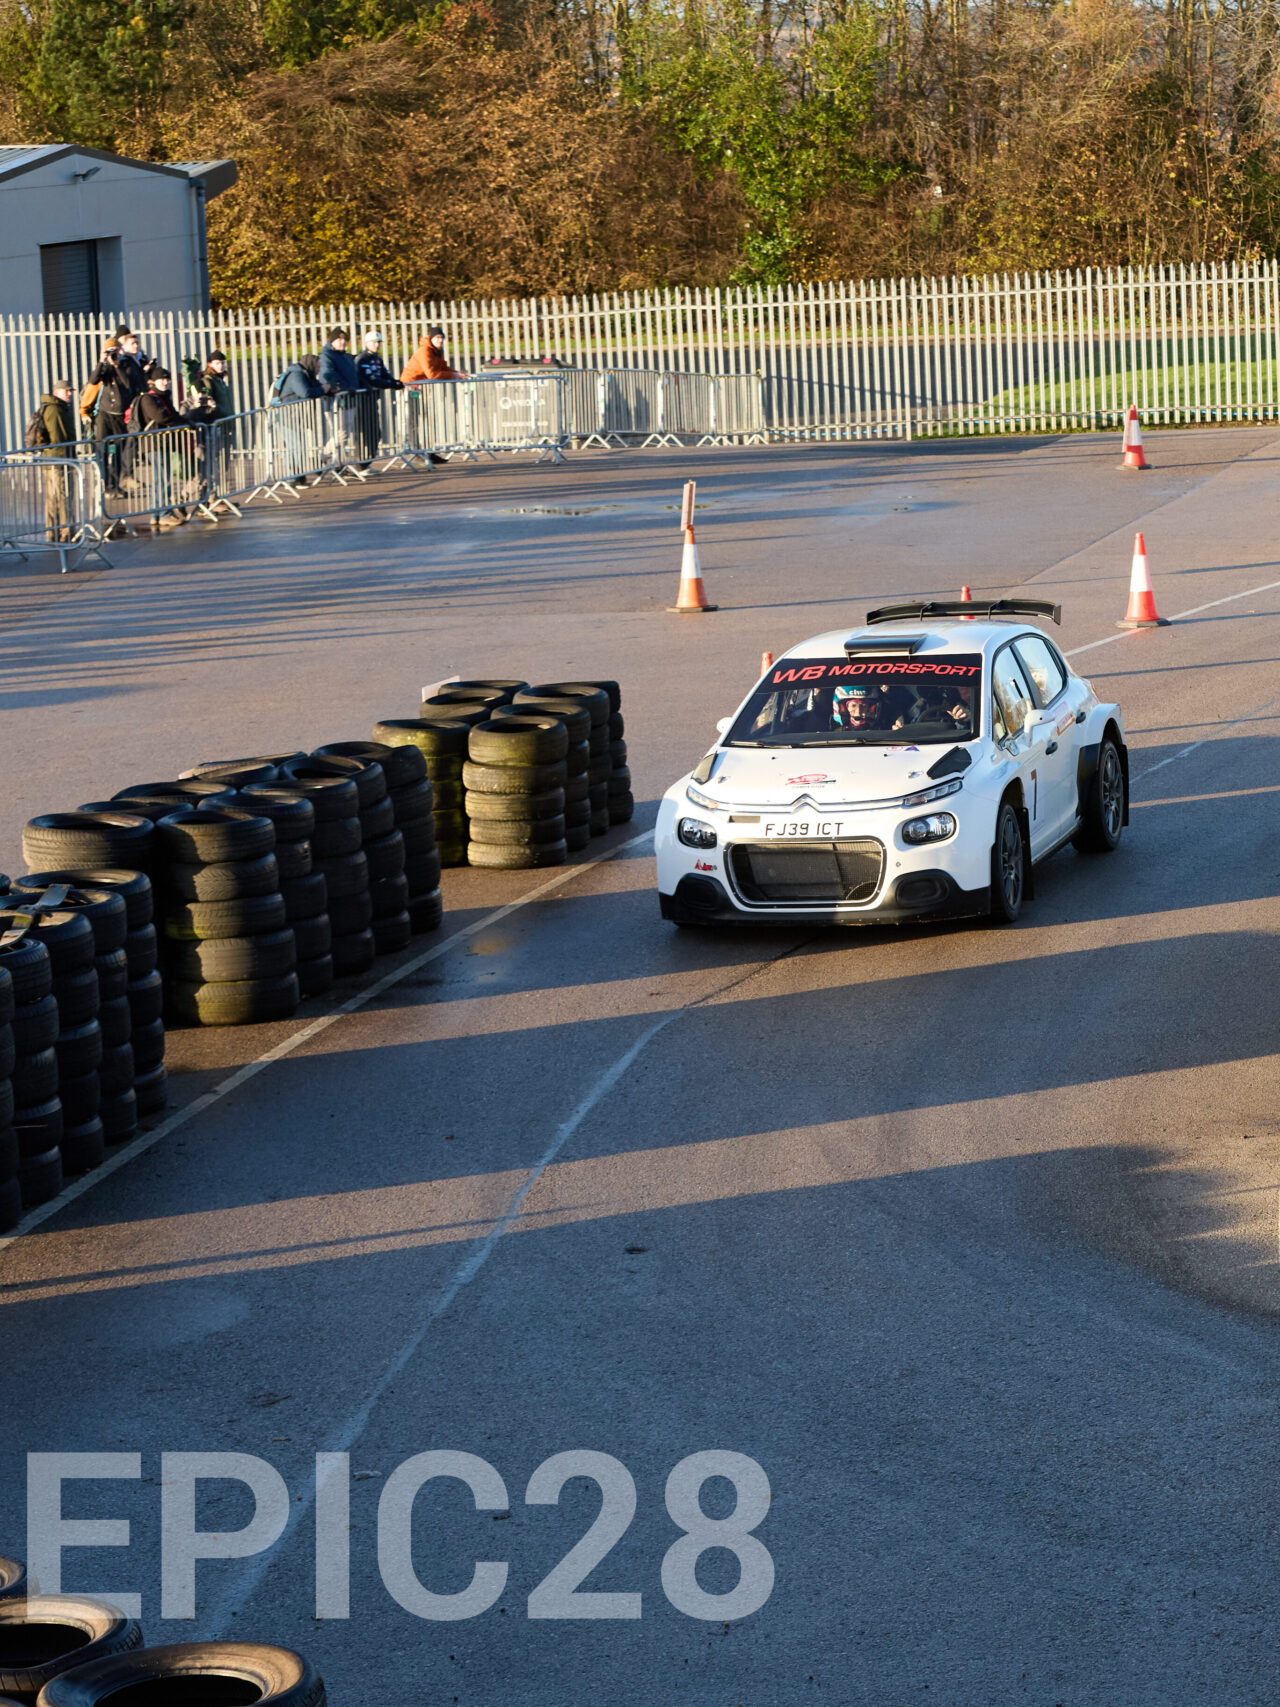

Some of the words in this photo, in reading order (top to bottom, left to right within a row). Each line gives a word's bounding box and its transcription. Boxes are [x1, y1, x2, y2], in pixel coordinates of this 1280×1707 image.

[772, 665, 827, 684] WB
[828, 663, 981, 677] MOTORSPORT
[765, 823, 809, 836] FJ39
[816, 822, 844, 835] ICT
